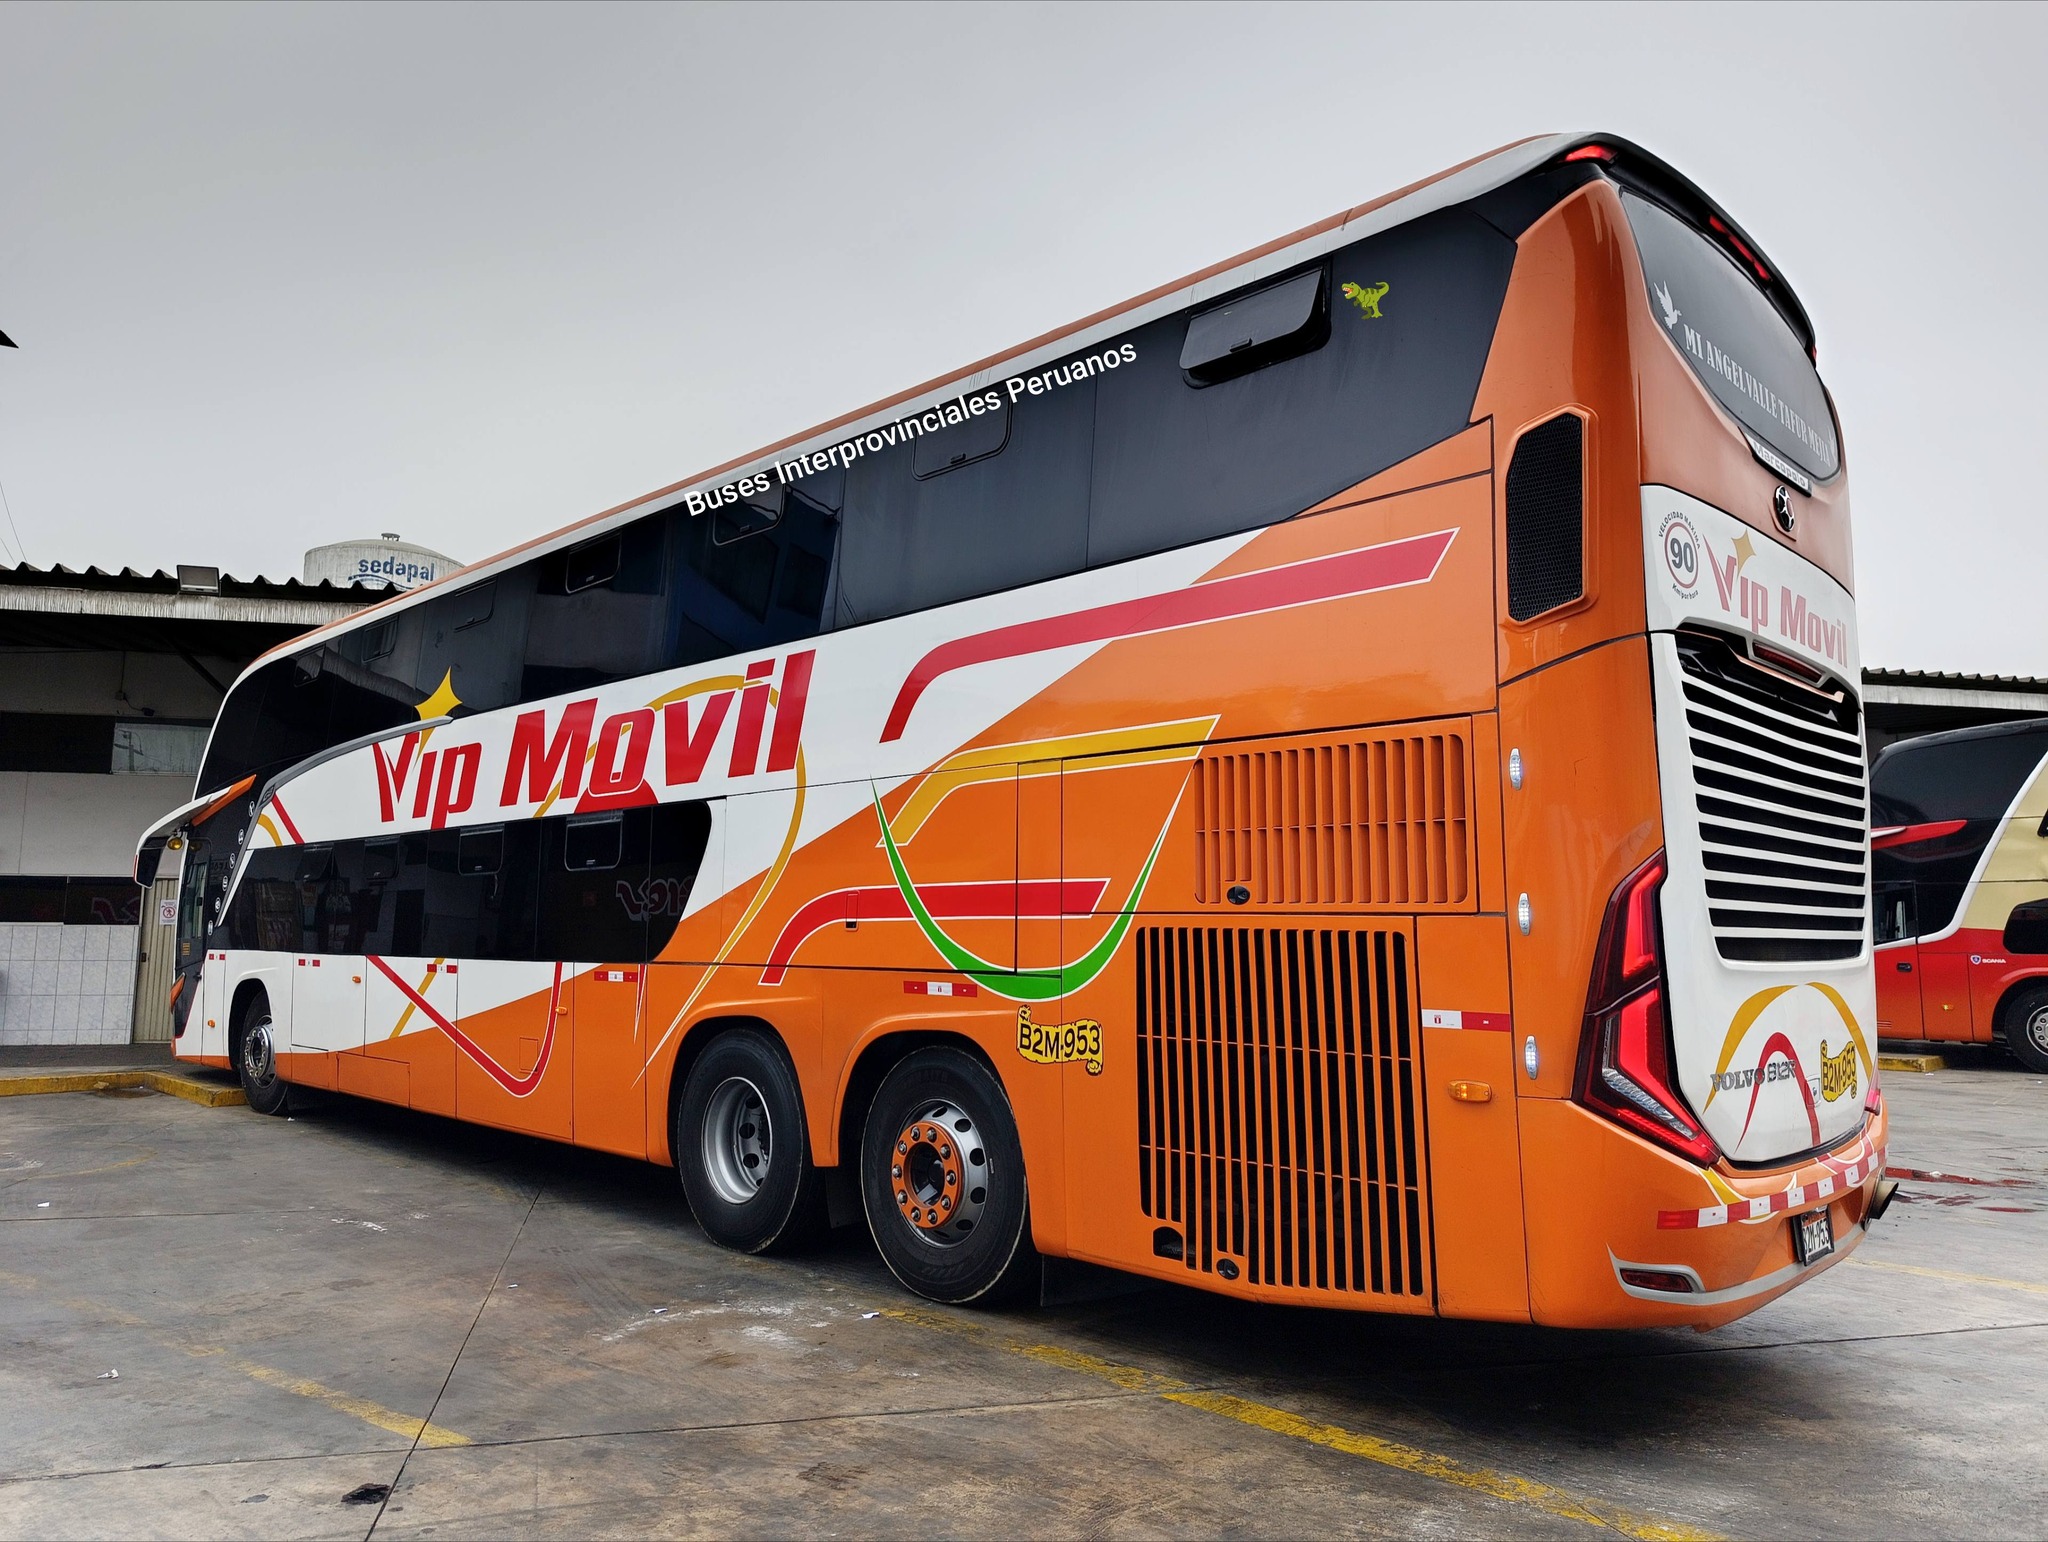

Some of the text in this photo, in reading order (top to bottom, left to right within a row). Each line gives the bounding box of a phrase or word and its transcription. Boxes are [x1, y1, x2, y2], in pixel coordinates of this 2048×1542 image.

[1683, 323, 1704, 360] MI
[1706, 339, 1746, 394] ANGEL
[1744, 371, 1778, 419] VALLE
[1778, 399, 1808, 445] TAFUR
[1658, 511, 1684, 538] VELOCIDAD
[358, 556, 435, 582] sedapal
[1670, 537, 1695, 573] 90
[1702, 533, 1848, 669] Vip Movil
[372, 648, 816, 829] Vip Movil
[1019, 1023, 1101, 1060] B2M-953
[1710, 1067, 1766, 1092] VOLVO
